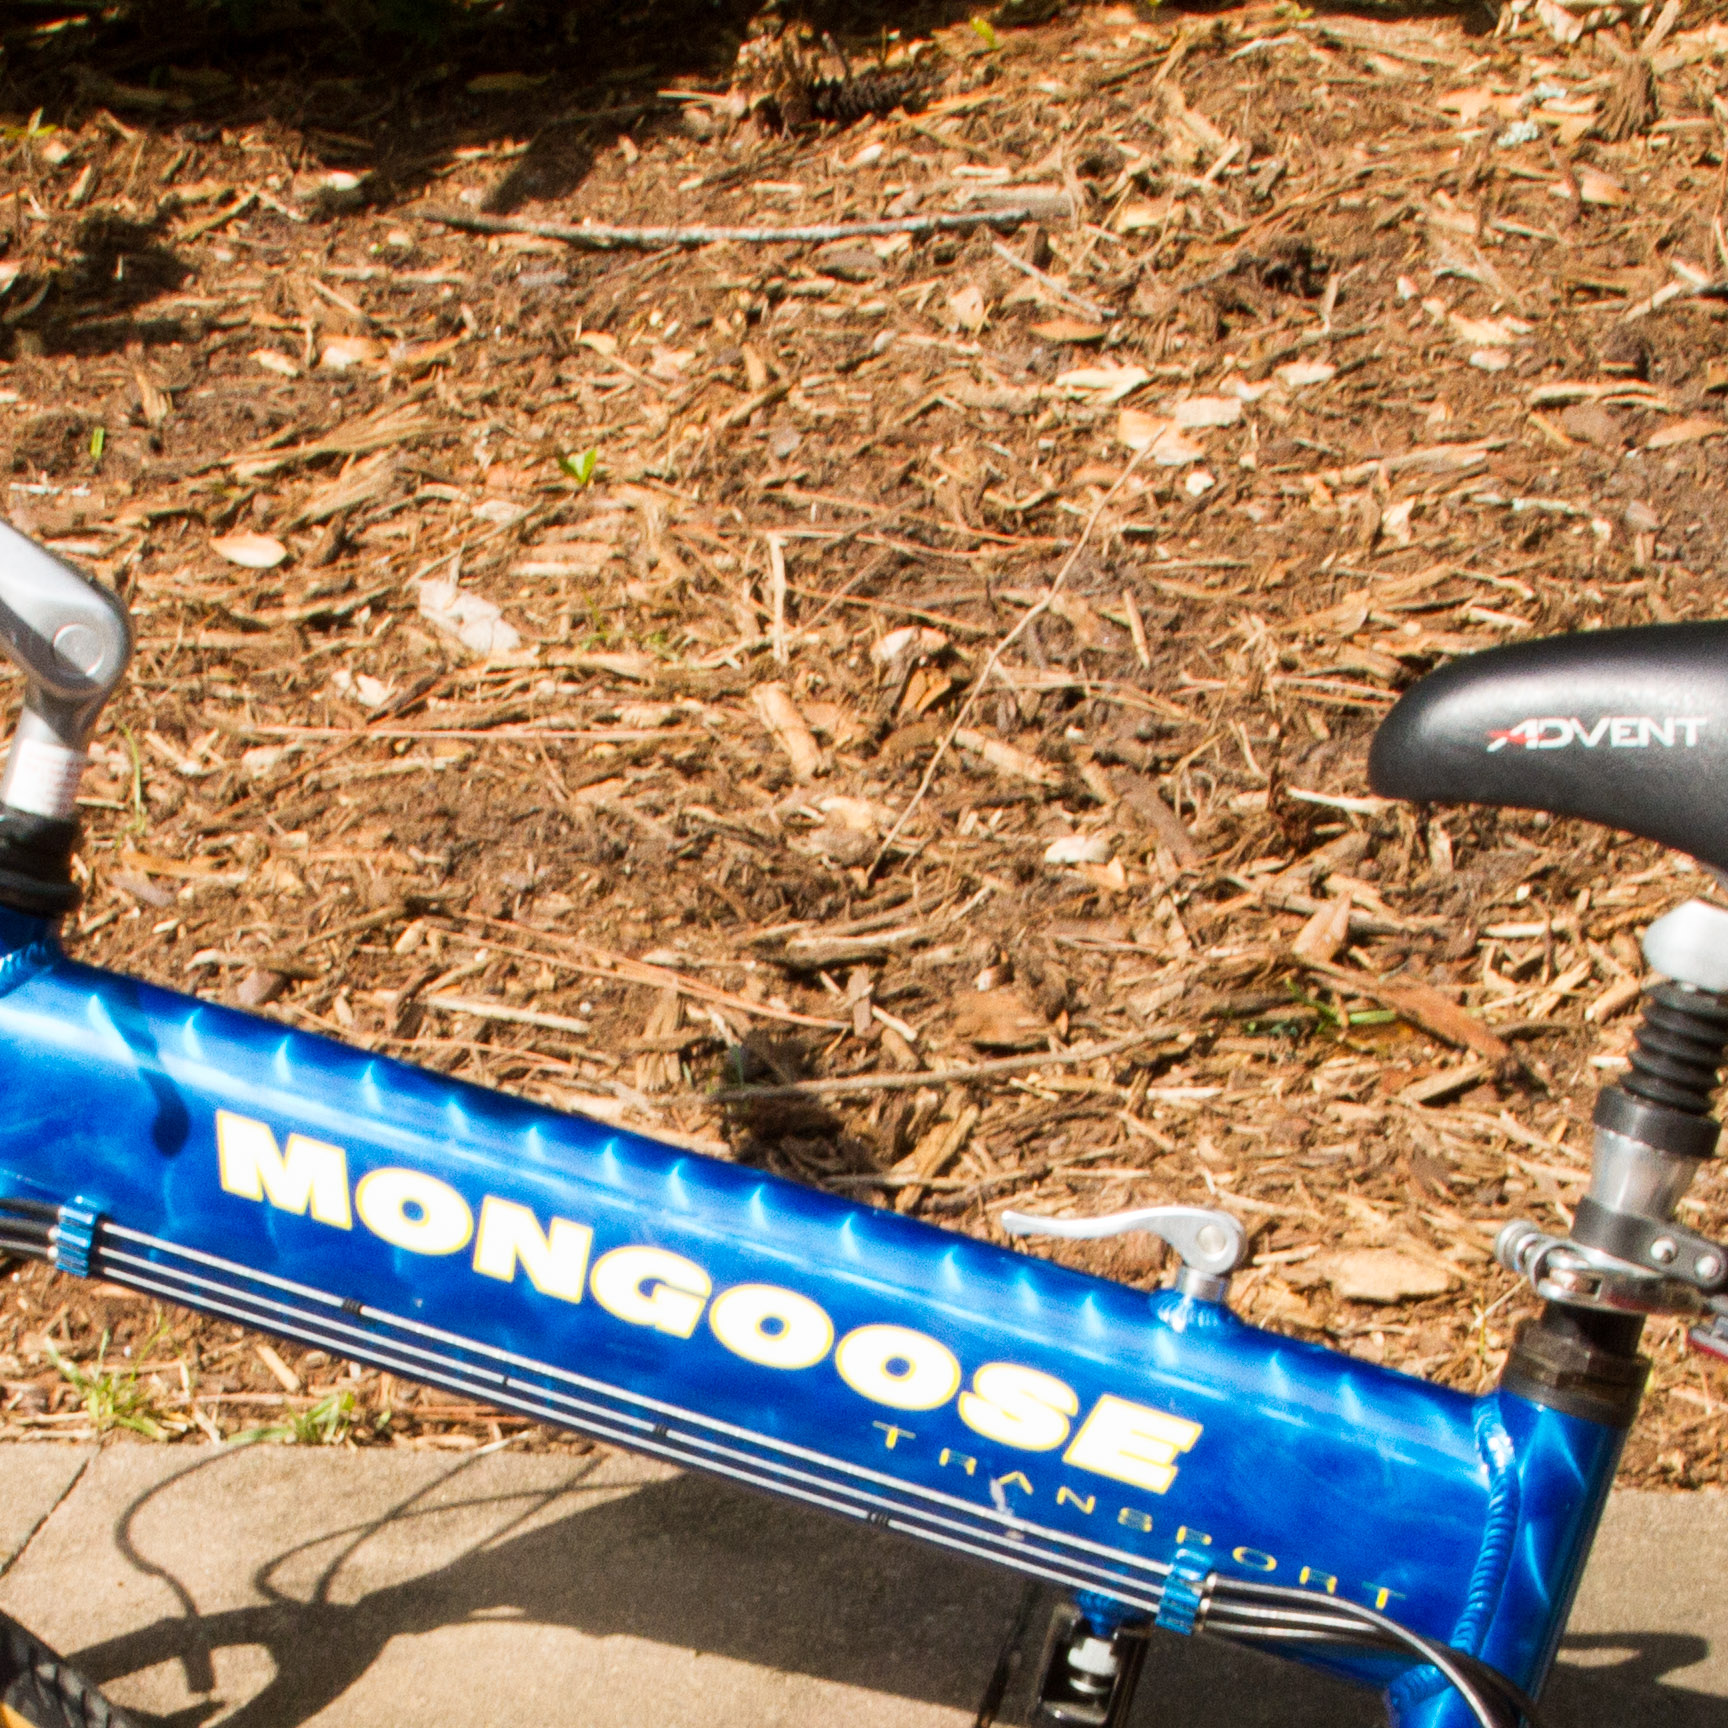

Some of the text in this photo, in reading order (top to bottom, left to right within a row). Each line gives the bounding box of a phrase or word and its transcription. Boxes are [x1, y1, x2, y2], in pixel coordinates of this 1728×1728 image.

[1486, 714, 1708, 753] ADVENT
[215, 1110, 1203, 1494] MONGOOSE
[873, 1419, 1406, 1610] TRANSPORT
